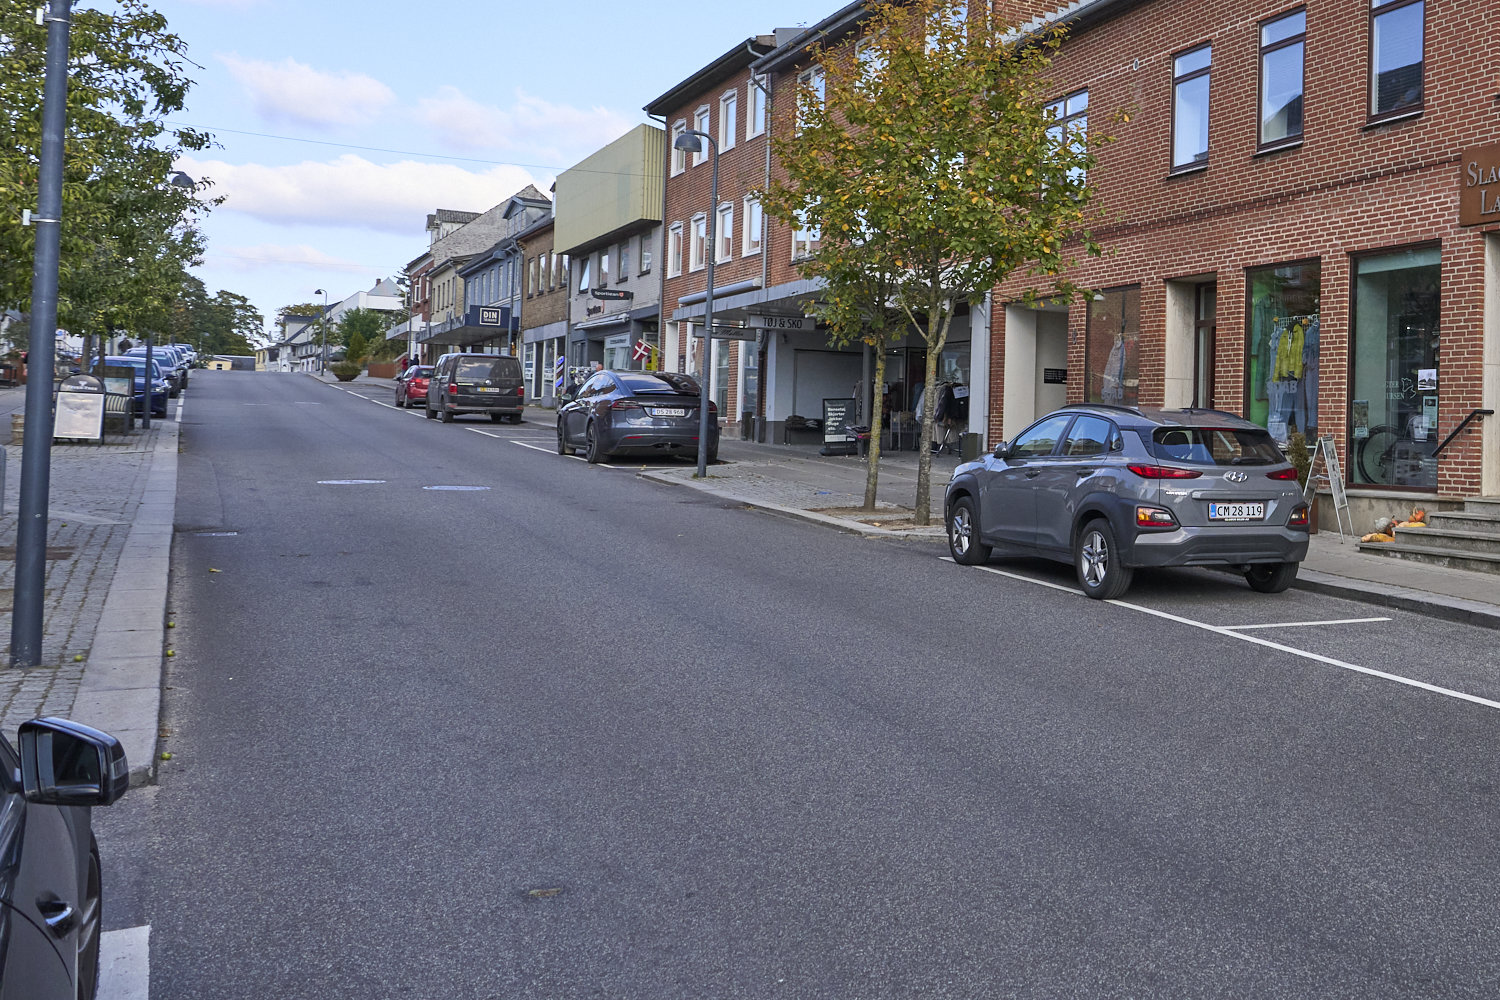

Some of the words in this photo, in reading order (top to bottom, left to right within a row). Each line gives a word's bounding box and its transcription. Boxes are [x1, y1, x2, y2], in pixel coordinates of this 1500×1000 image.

[483, 310, 498, 319] DIN
[763, 317, 778, 328] TØJ
[778, 318, 786, 328] &
[787, 318, 803, 329] SKO
[1217, 505, 1230, 516] CM
[1232, 505, 1243, 516] 28
[1246, 505, 1262, 516] 119
